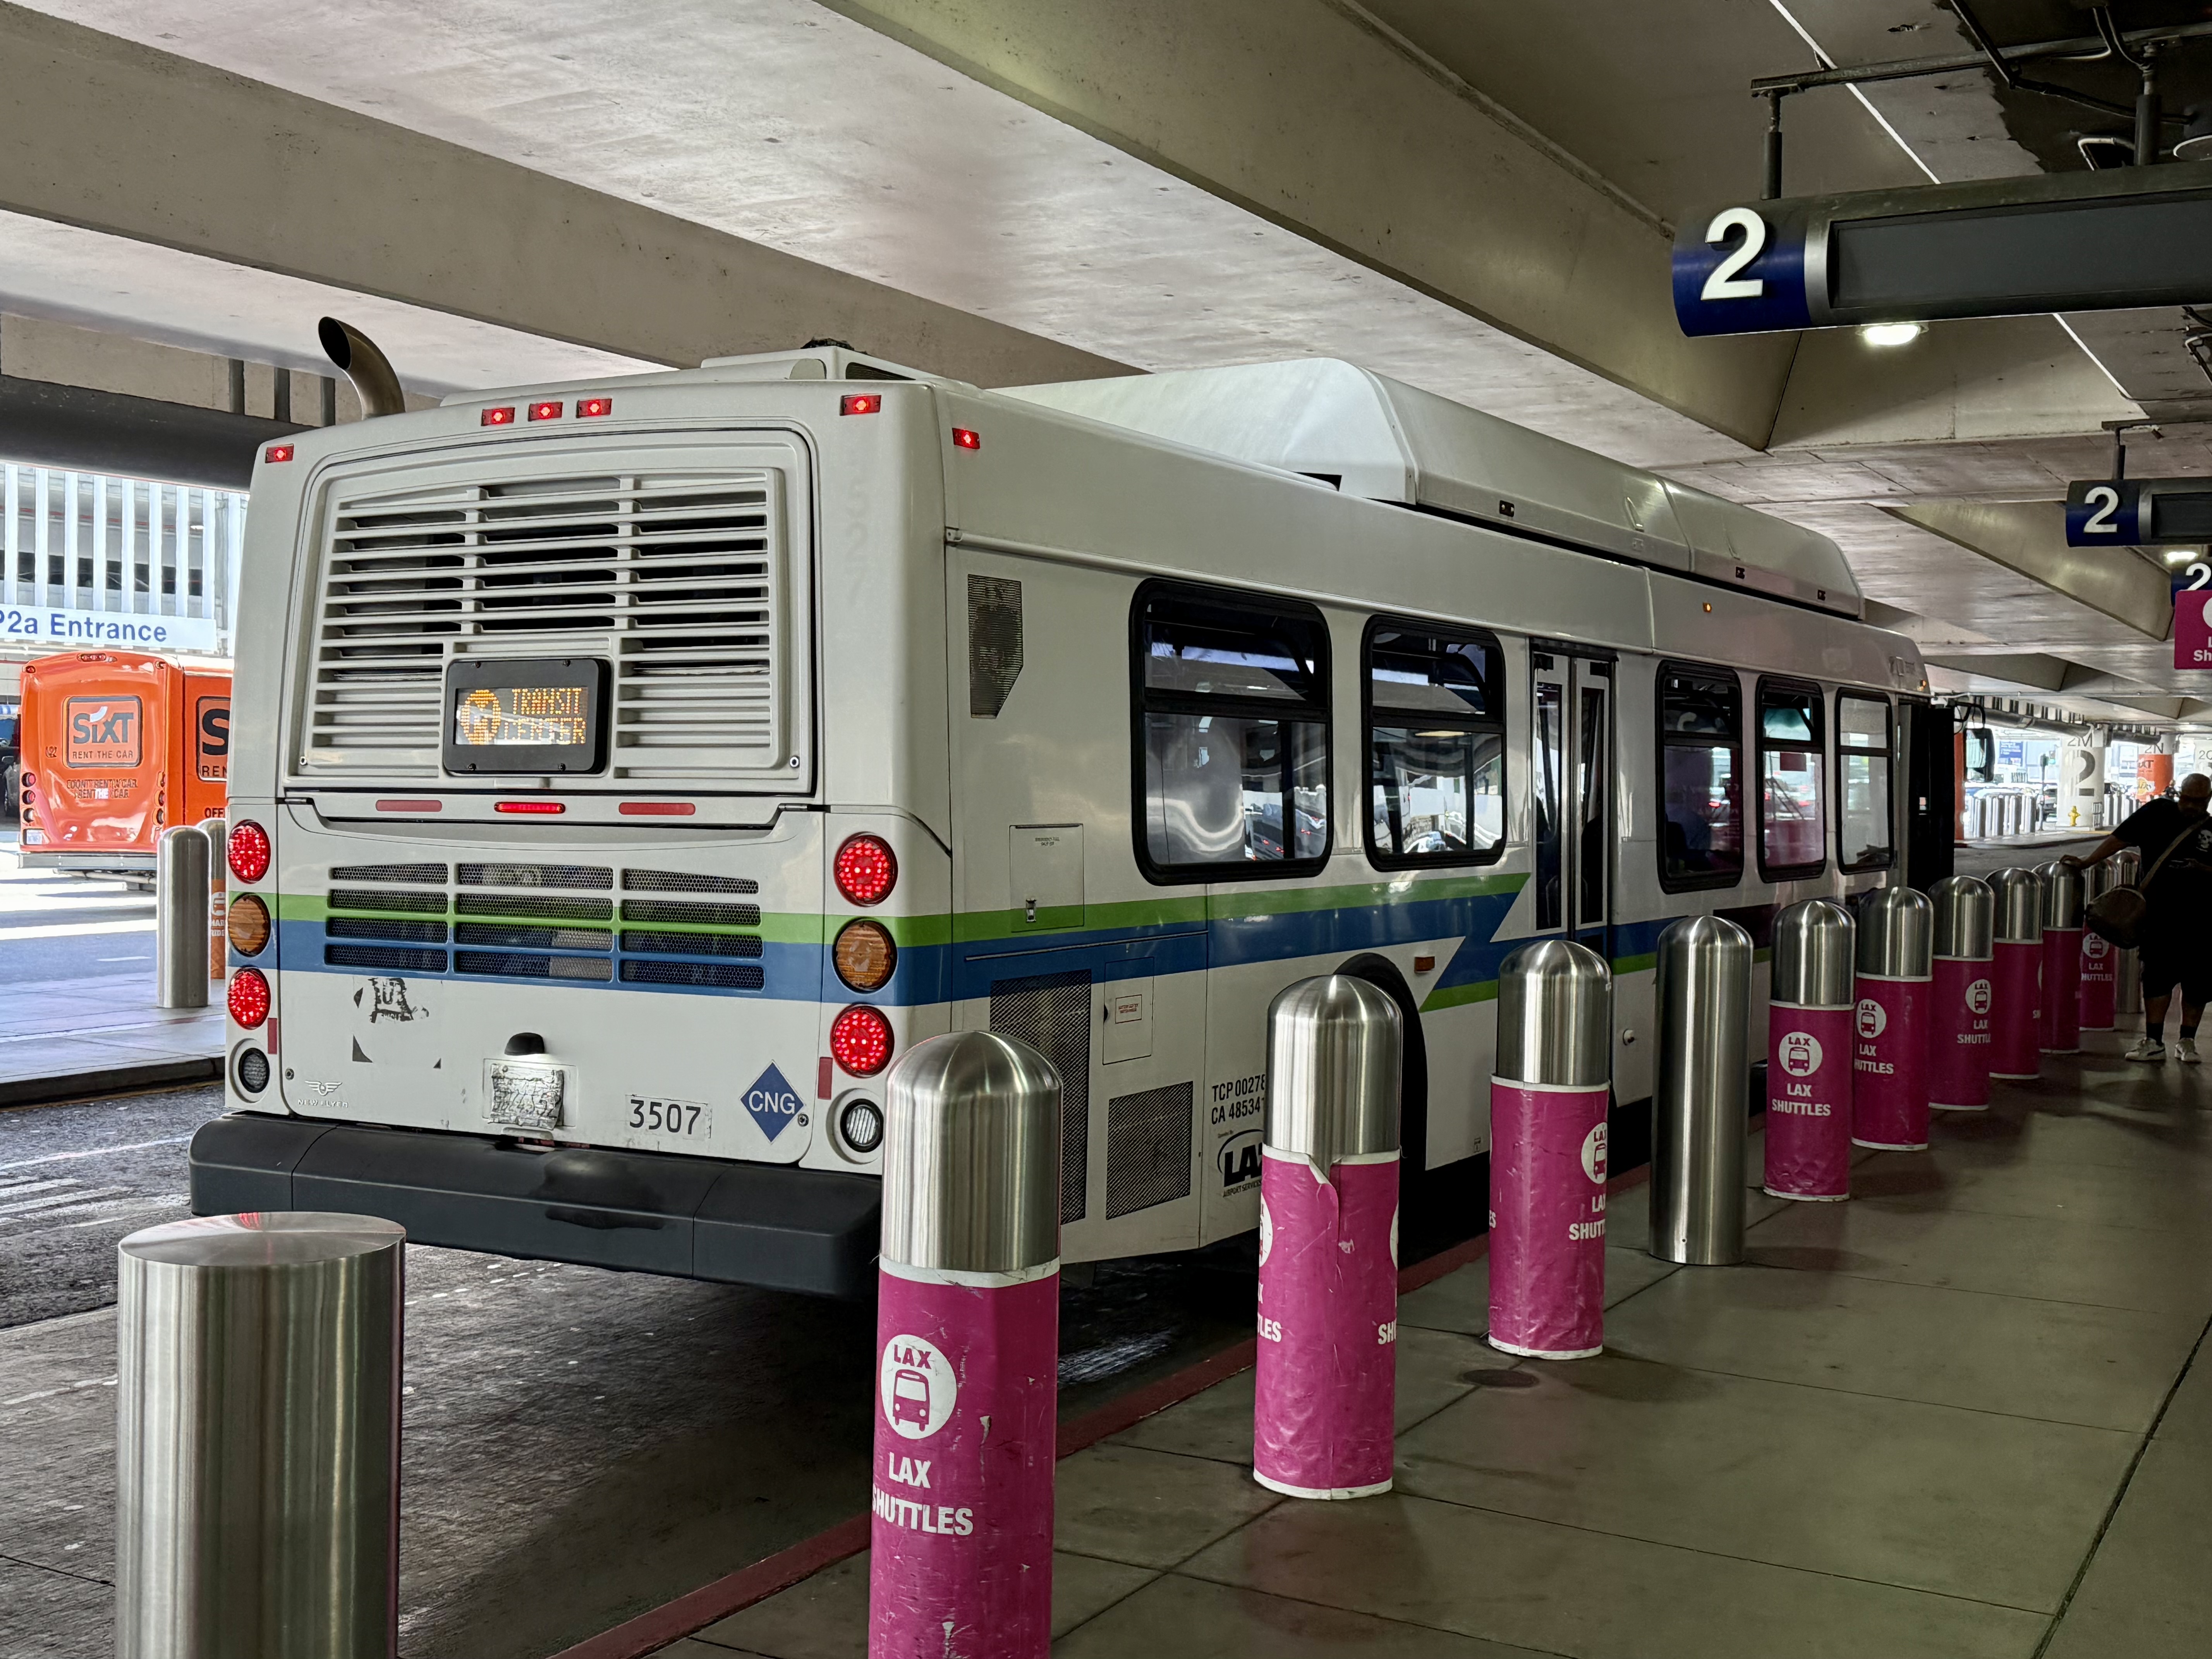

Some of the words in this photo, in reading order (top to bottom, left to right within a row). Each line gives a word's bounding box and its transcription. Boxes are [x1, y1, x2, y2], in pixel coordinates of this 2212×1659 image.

[1701, 208, 1765, 301] 2
[2083, 486, 2118, 533] 2
[2186, 563, 2211, 590] 2
[51, 614, 167, 642] Entrance
[512, 688, 582, 714] TRANSIT
[73, 707, 134, 744] SIXT
[72, 751, 93, 759] RENT
[97, 750, 112, 758] THE
[116, 750, 133, 758] CAR
[2069, 750, 2095, 796] 2
[2089, 962, 2104, 970] LAX
[1861, 1003, 1876, 1012] LAX
[1973, 1020, 1988, 1030] LAX
[1788, 1036, 1811, 1047] LAX
[1860, 1044, 1876, 1056] LAX
[749, 1091, 795, 1114] CNG
[1212, 1082, 1233, 1102] TCP
[1787, 1083, 1812, 1097] LAX
[629, 1099, 701, 1135] 3507
[1211, 1105, 1226, 1125] CA
[1229, 1096, 1265, 1120] 48534
[1772, 1099, 1831, 1116] SHUTTLES
[1224, 1142, 1262, 1187] LA
[893, 1345, 932, 1370] LAX
[888, 1451, 931, 1489] LAX
[872, 1483, 974, 1536] SHUTTLES
